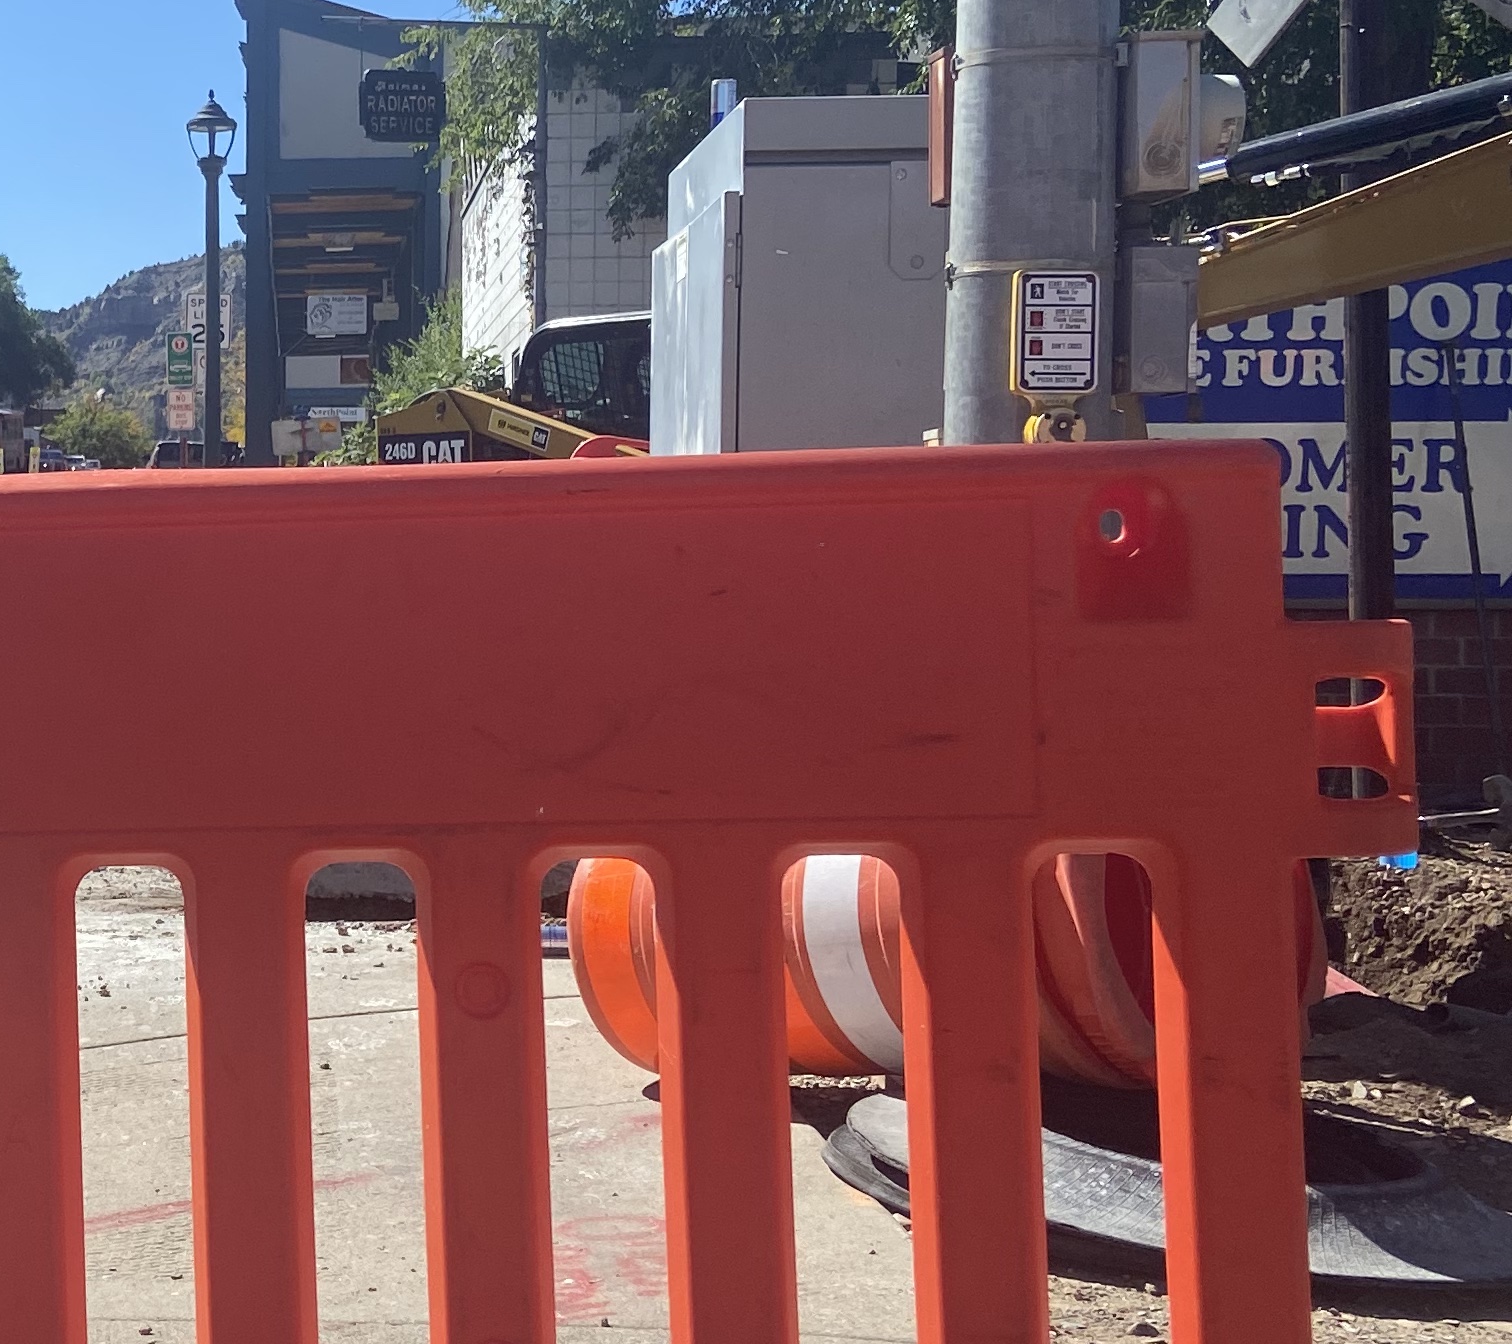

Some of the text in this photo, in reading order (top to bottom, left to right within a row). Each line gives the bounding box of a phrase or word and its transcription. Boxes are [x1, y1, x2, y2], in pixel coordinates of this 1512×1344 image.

[368, 96, 436, 113] RADIATOR
[385, 440, 465, 464] 246D CAT
